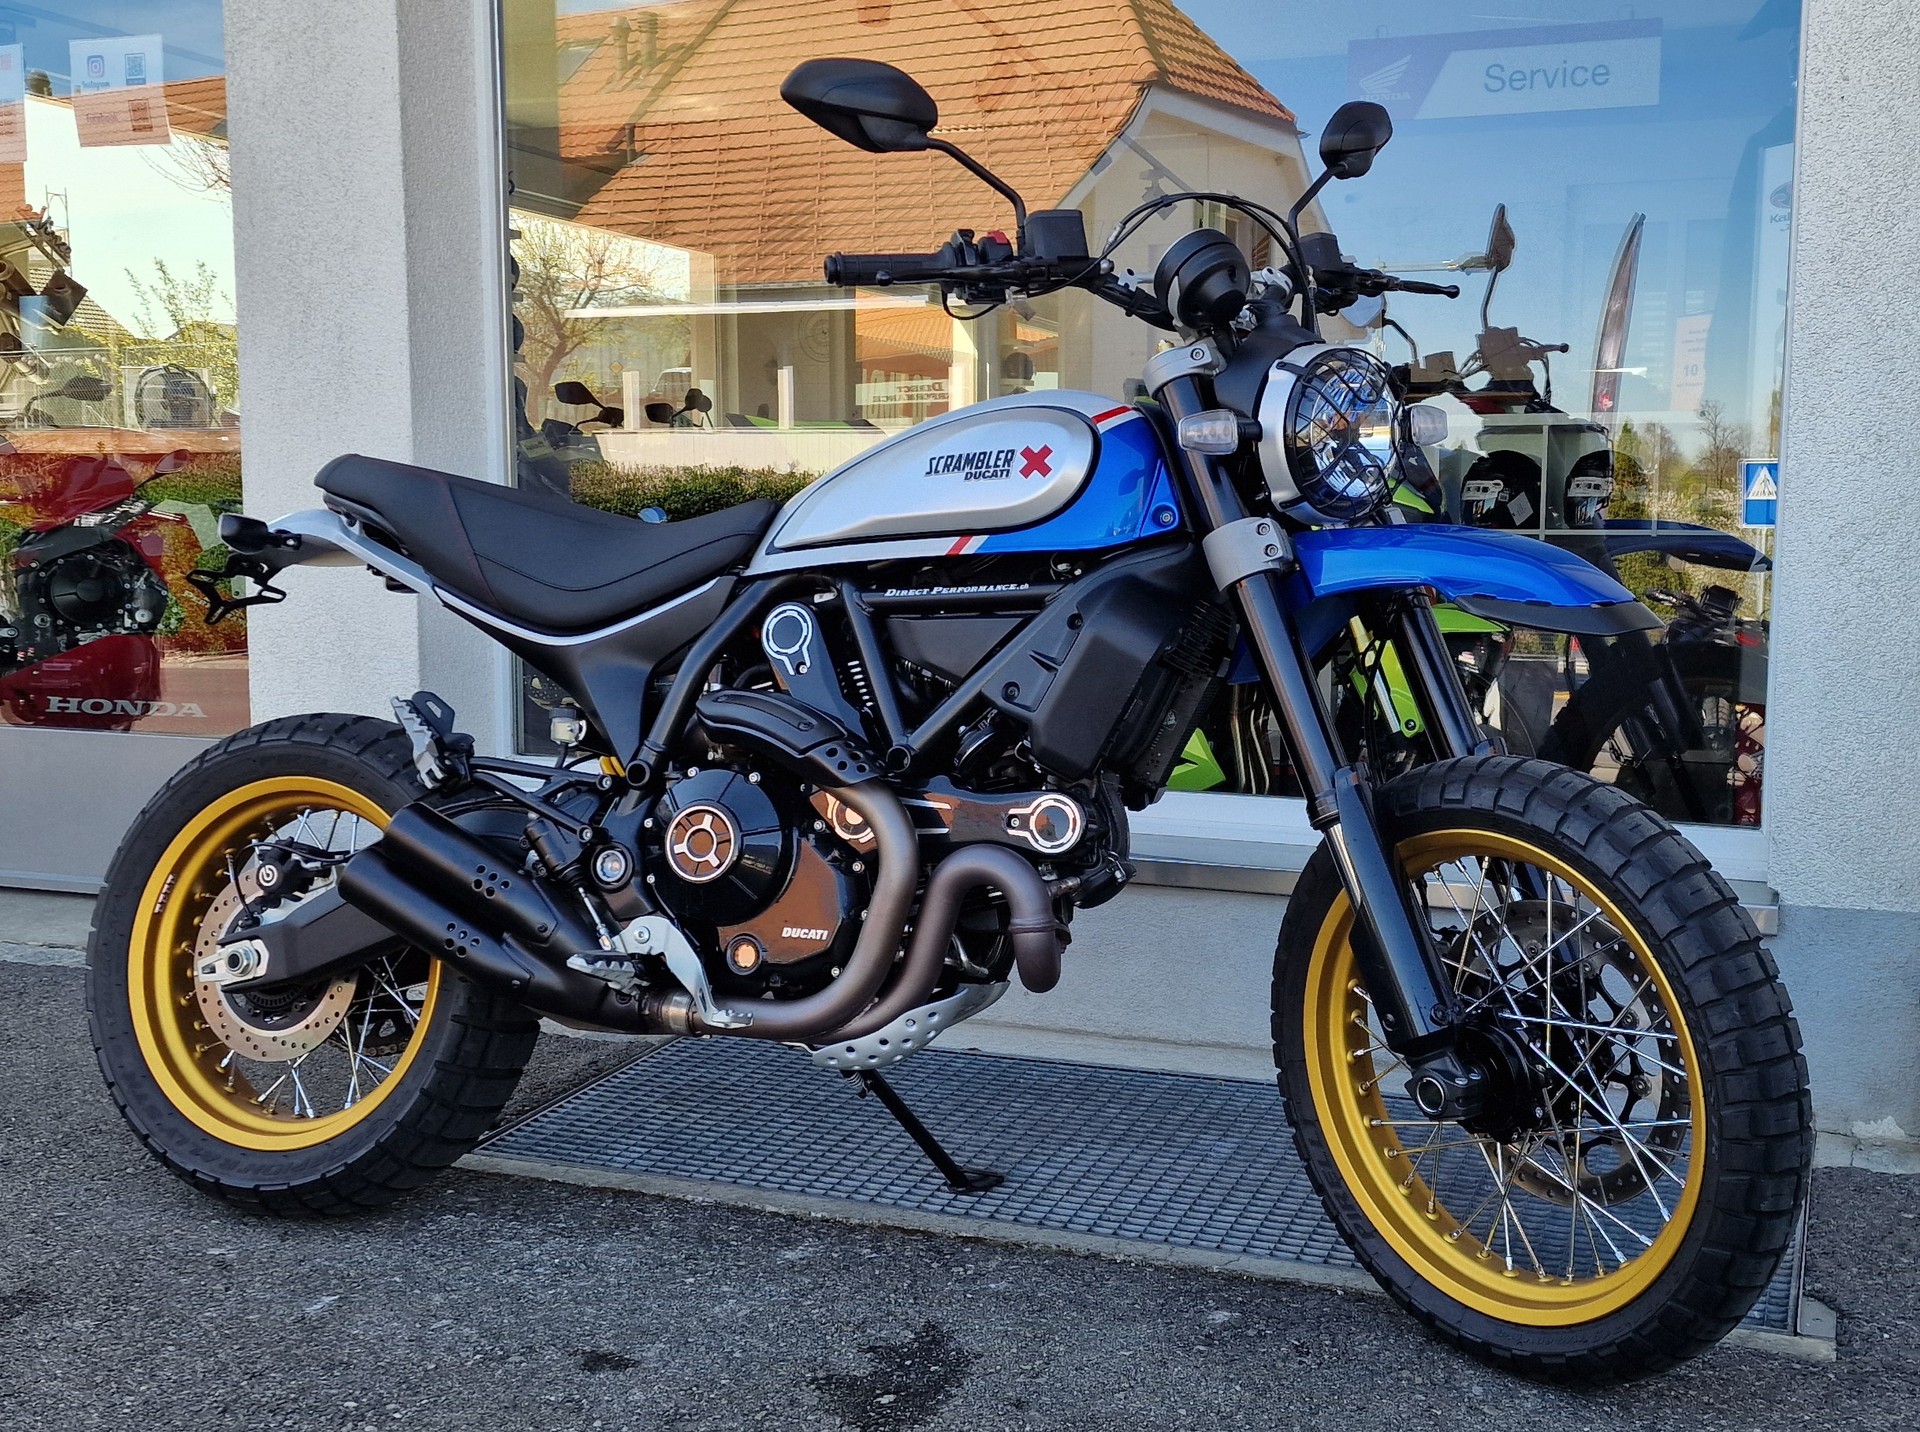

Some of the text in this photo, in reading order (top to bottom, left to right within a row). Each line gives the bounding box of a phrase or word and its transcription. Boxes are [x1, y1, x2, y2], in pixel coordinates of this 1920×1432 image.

[1484, 60, 1610, 93] Service
[1683, 364, 1698, 376] 10
[925, 449, 1016, 475] SCRAMBLER
[964, 469, 1010, 480] DUCATI
[884, 588, 930, 597] DIRECT
[46, 696, 207, 718] HONDA
[782, 927, 829, 940] DUCATI
